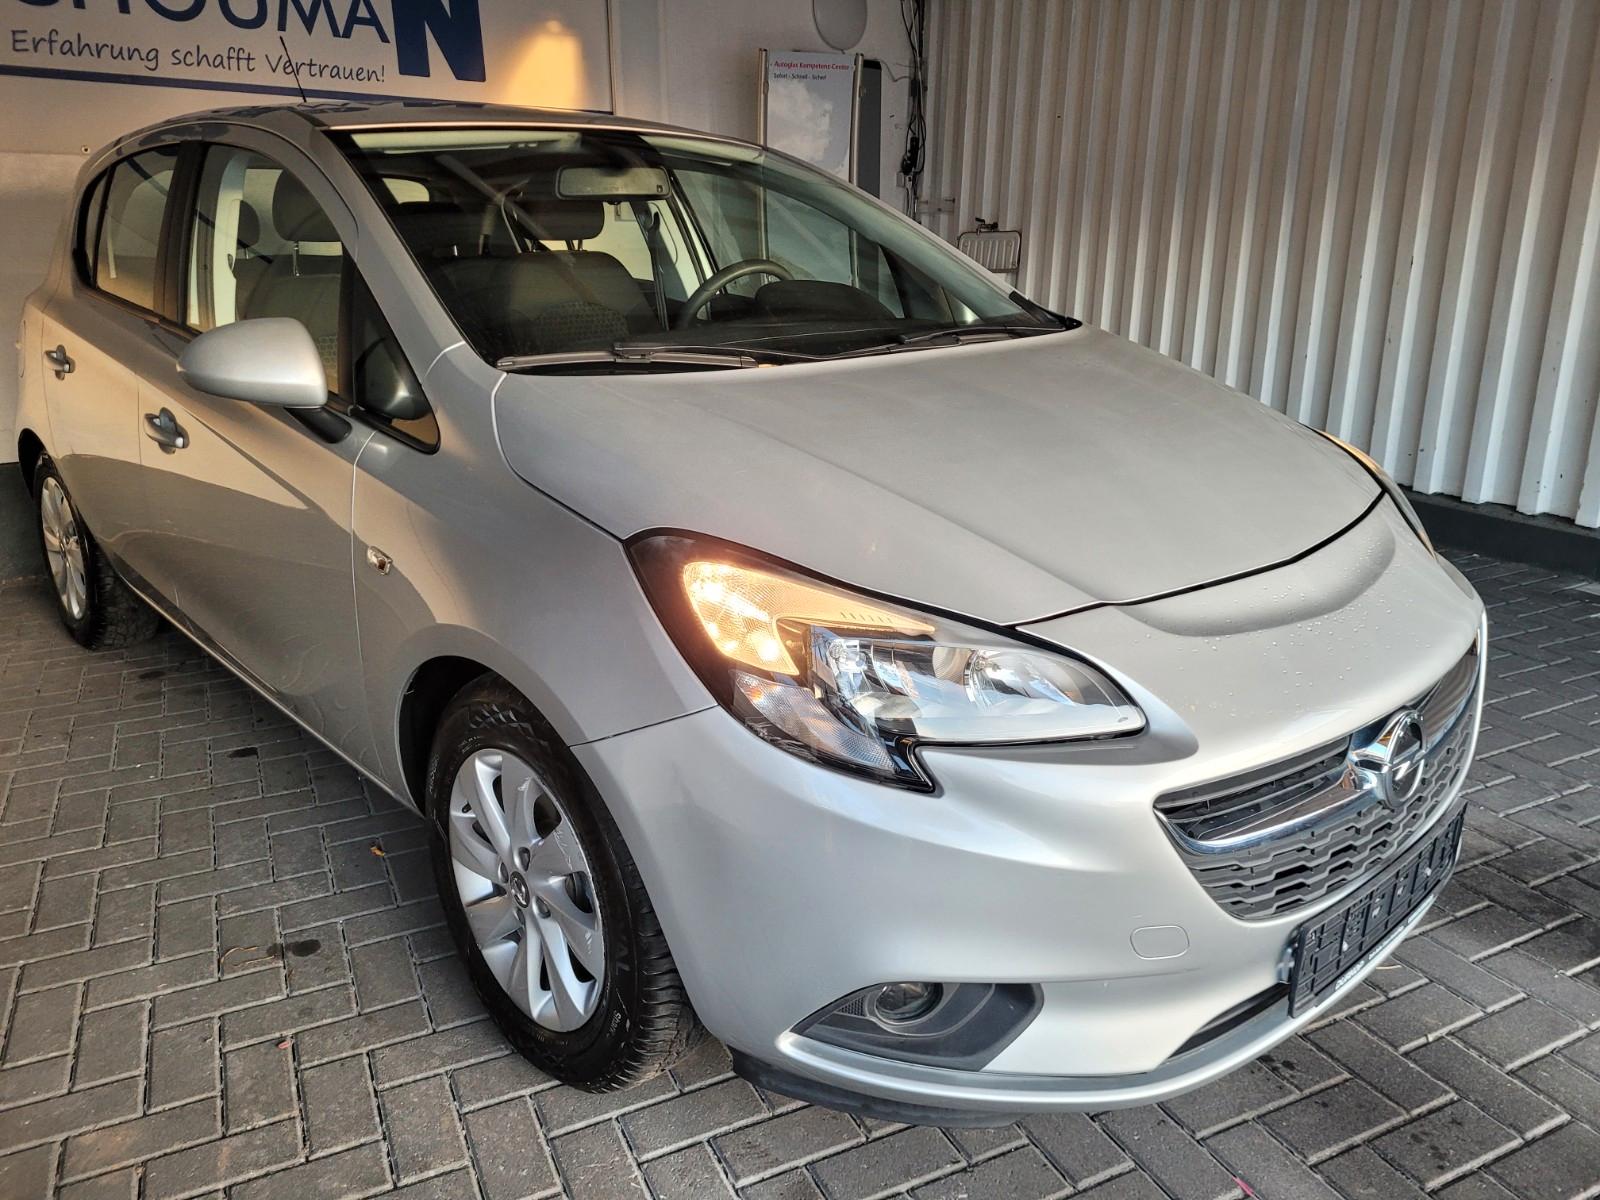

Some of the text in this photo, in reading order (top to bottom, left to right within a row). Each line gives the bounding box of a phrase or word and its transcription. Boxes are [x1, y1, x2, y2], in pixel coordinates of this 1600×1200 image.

[11, 29, 386, 82] Erfahrung schafft Vertrauen!
